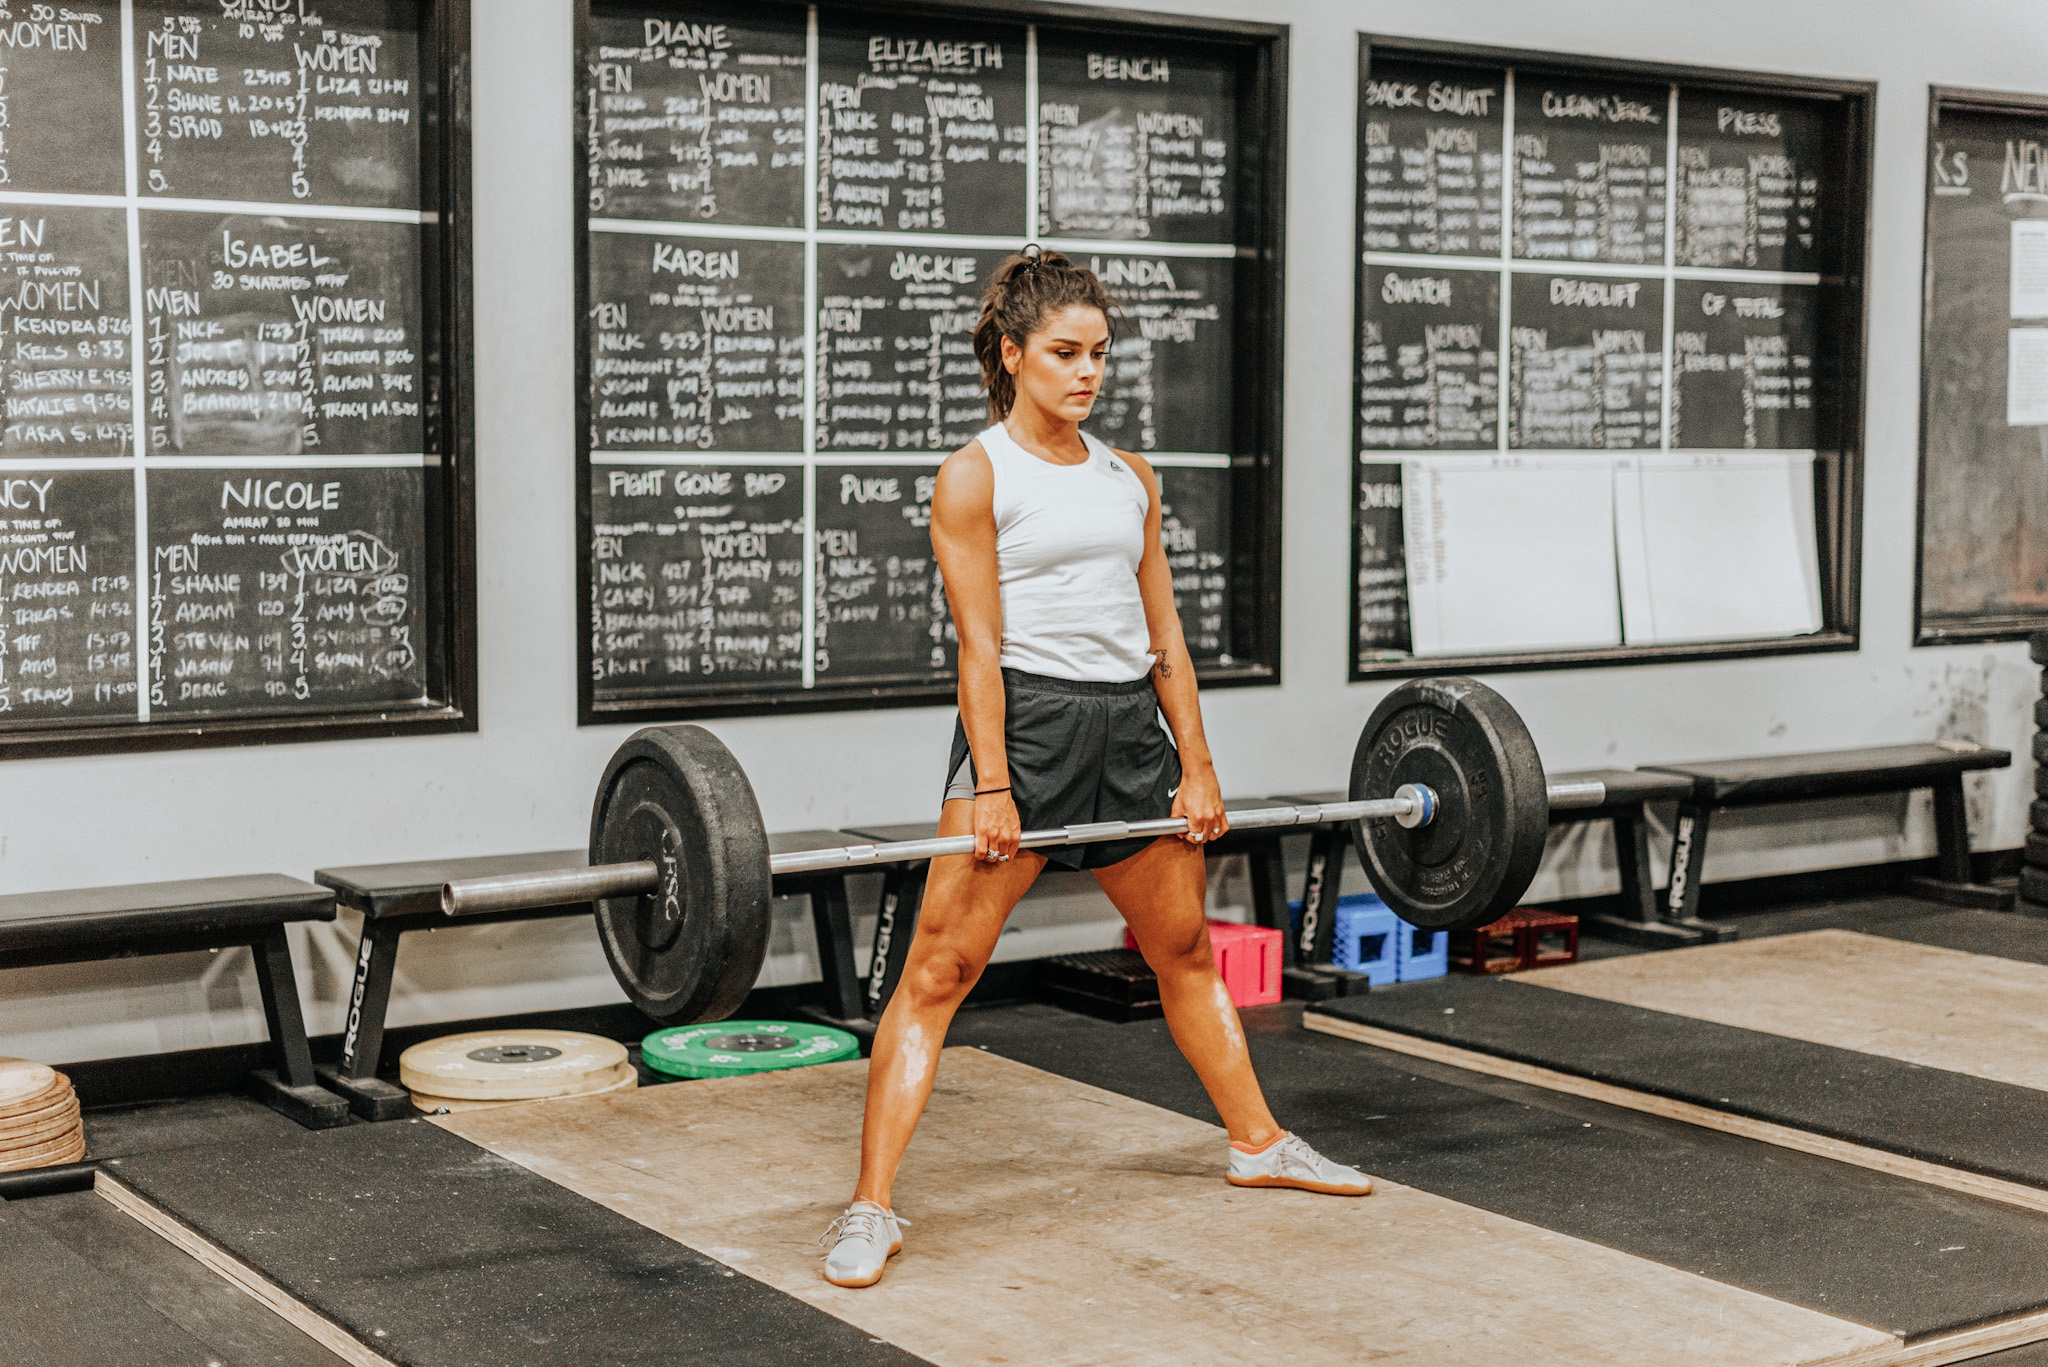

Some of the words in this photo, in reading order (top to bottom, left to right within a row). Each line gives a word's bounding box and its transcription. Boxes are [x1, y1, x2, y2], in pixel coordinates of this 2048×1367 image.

[30, 4, 55, 21] 50
[163, 17, 175, 32] 5
[239, 24, 255, 39] 10
[644, 18, 733, 49] DIANE
[148, 30, 198, 60] MEN
[294, 42, 377, 75] WOMEN
[868, 36, 1003, 69] ELIZABETH
[167, 64, 219, 84] NATE
[1087, 53, 1170, 83] BENCH
[316, 75, 361, 97] LIZA
[699, 71, 770, 104] WOMEN
[820, 82, 862, 109] MEN
[1426, 80, 1496, 117] SQUAT
[167, 88, 223, 114] SHANE
[925, 94, 993, 121] WOMEN
[167, 115, 223, 140] SROD
[1717, 106, 1782, 138] PRESS
[223, 230, 330, 269] ISABEL
[653, 242, 740, 280] KAREN
[211, 270, 234, 291] 30
[890, 251, 977, 283] JACKIE
[1091, 255, 1176, 290] LINDA
[146, 287, 200, 316] MEN
[1382, 272, 1453, 308] SNATCH
[1550, 277, 1641, 308] DEADLIFT
[291, 294, 386, 323] WOMEN
[701, 304, 774, 333] WOMEN
[14, 315, 96, 335] KENDRA
[177, 321, 225, 340] NICK
[16, 341, 68, 360] KELS
[77, 340, 124, 360] 8:33
[10, 370, 84, 390] SHERRY
[181, 367, 250, 391] ANDREY
[6, 397, 77, 418] NATALIE
[5, 424, 65, 444] TARA
[221, 478, 341, 511] NICOLE
[609, 469, 666, 497] FIGHT
[674, 470, 733, 496] GONE
[744, 472, 786, 497] BAD
[222, 516, 268, 529] AMRAP
[700, 532, 767, 558] WOMEN
[816, 528, 858, 556] MEN
[155, 545, 198, 573] MEN
[293, 541, 379, 573] WOMEN
[171, 574, 242, 595] SHANE
[601, 561, 646, 585] NICK
[315, 577, 358, 597] LIZA
[175, 601, 236, 622] ADAM
[316, 601, 355, 623] AMY
[12, 633, 41, 653] TIFF
[173, 632, 250, 650] STEVEN
[20, 686, 73, 707] TRACY
[1301, 854, 1326, 951] ROGUE
[868, 892, 899, 1000] ROGUE
[343, 936, 373, 1058] ROGUE
